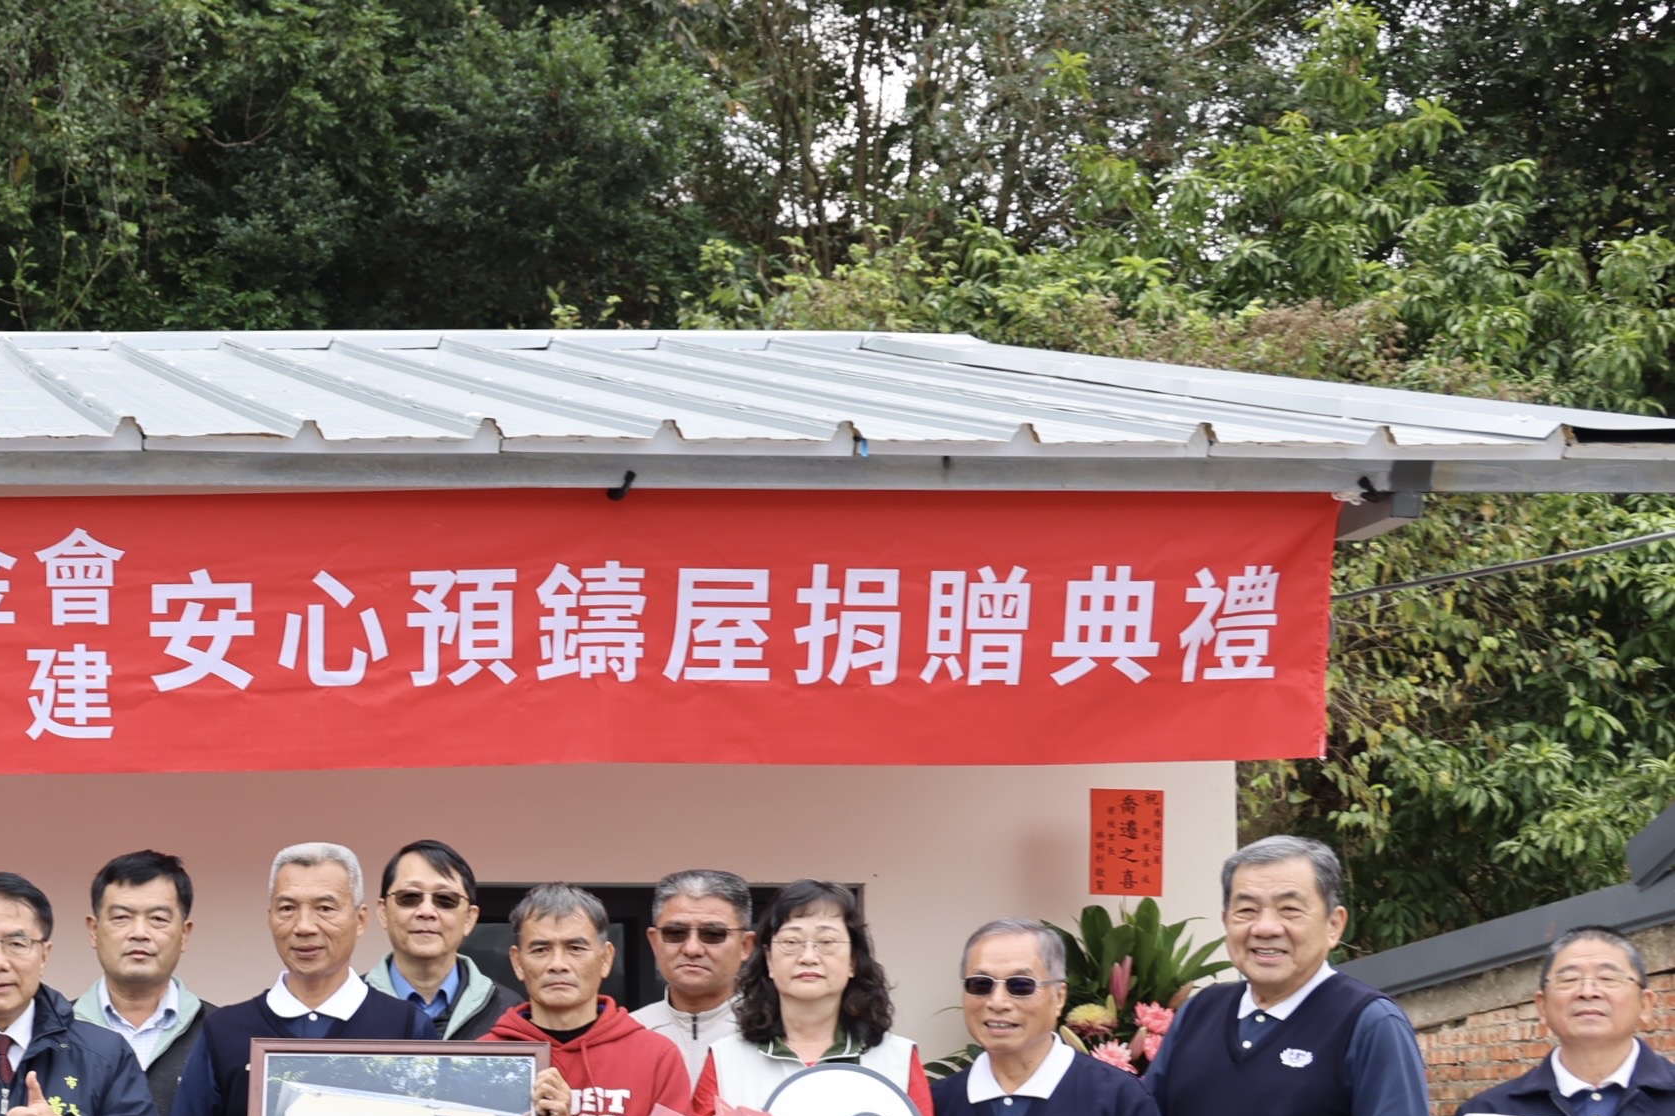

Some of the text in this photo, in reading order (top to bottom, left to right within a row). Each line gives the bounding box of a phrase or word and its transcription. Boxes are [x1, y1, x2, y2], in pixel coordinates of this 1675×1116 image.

[148, 561, 1280, 693] 安心預鑄屋捐贈典禮
